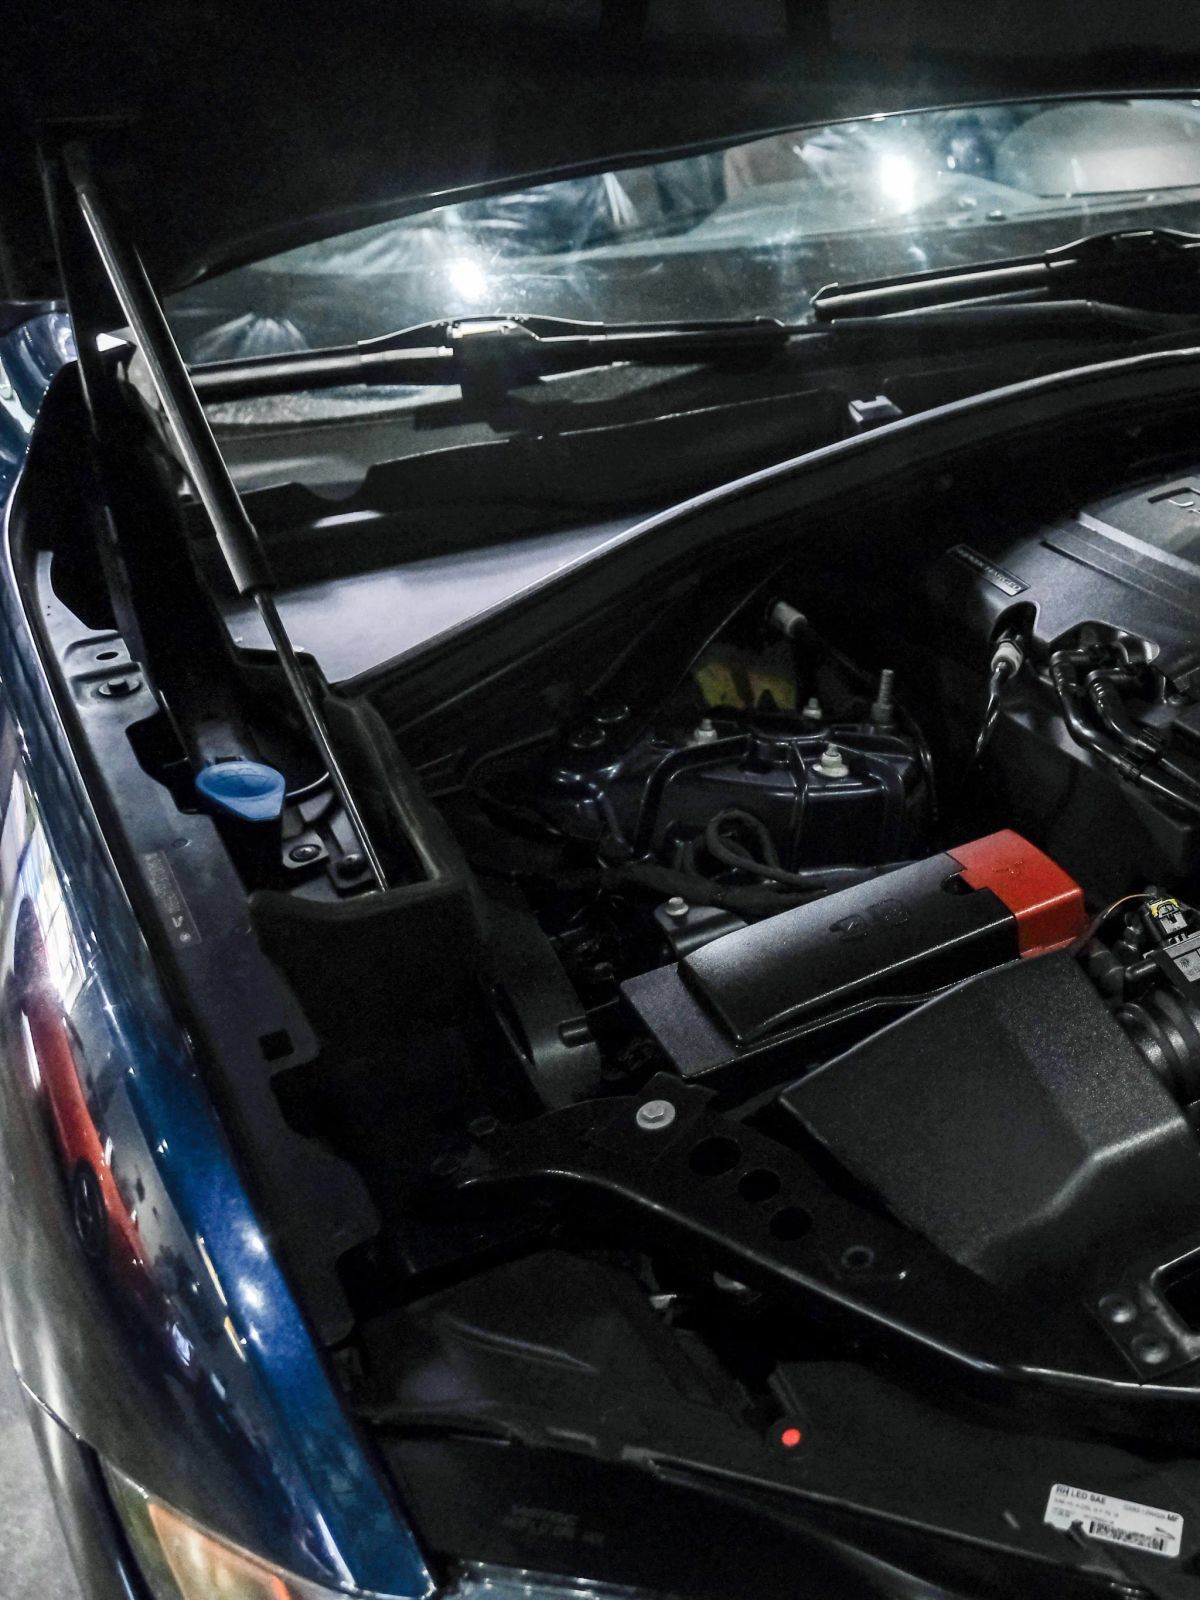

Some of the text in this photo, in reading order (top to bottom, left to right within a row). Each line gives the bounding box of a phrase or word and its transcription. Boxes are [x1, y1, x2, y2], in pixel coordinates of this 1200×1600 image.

[1056, 1485, 1107, 1505] RH LED SAE
